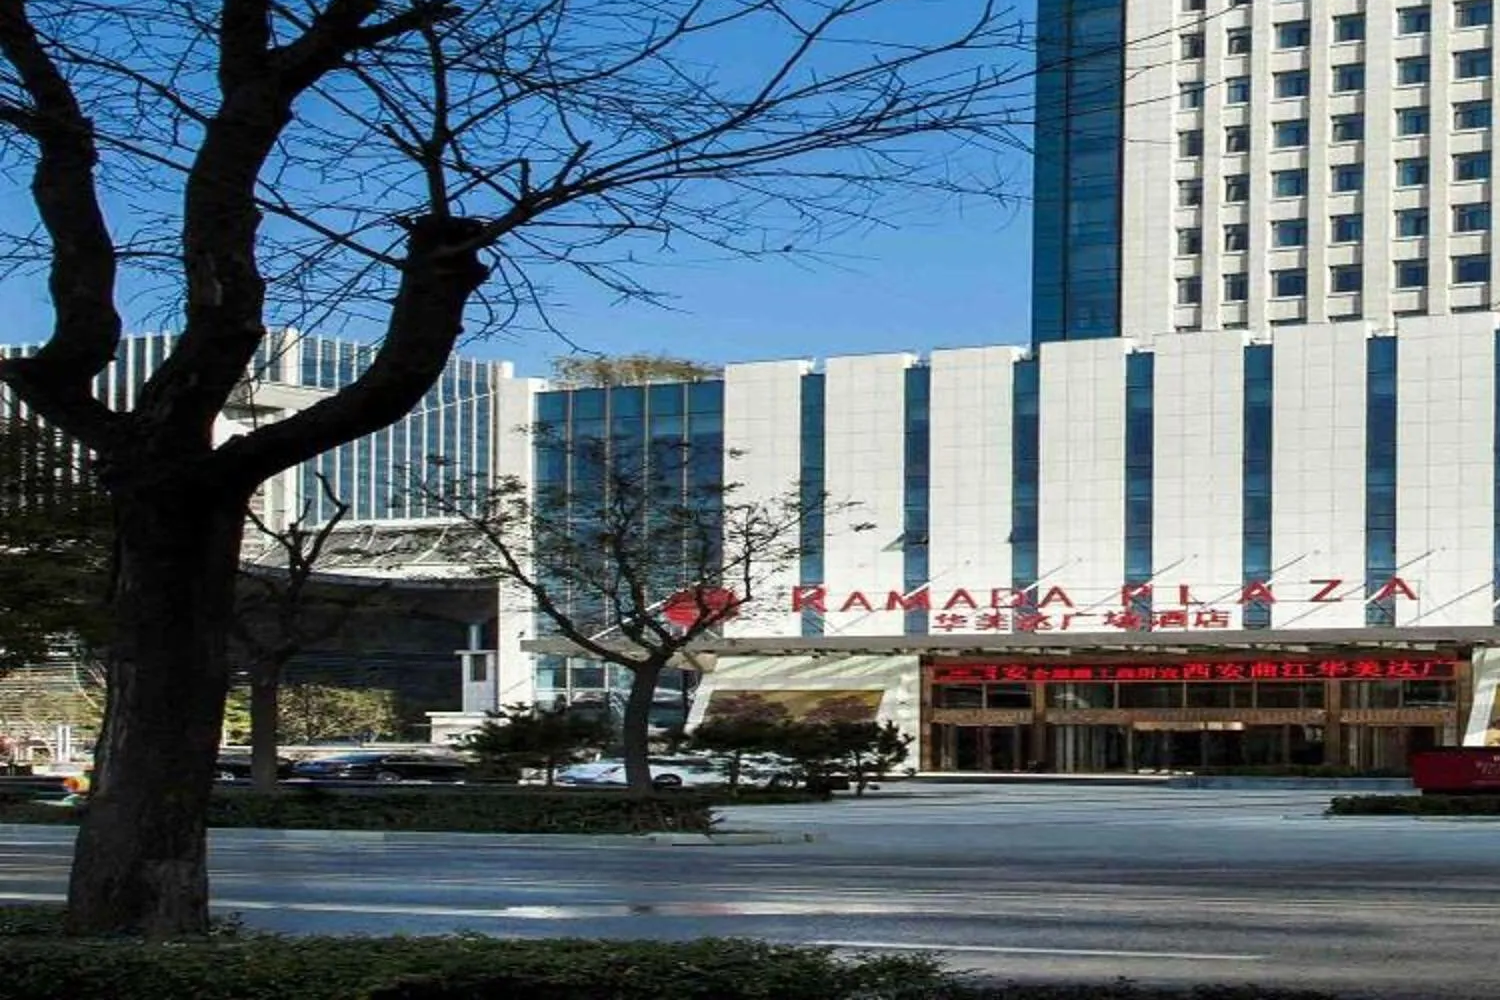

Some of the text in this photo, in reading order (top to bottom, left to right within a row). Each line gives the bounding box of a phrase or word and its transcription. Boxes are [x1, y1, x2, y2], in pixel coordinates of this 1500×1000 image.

[791, 577, 1418, 613] RAMADA PLAZA
[932, 610, 1231, 632] 华美达广场酒店
